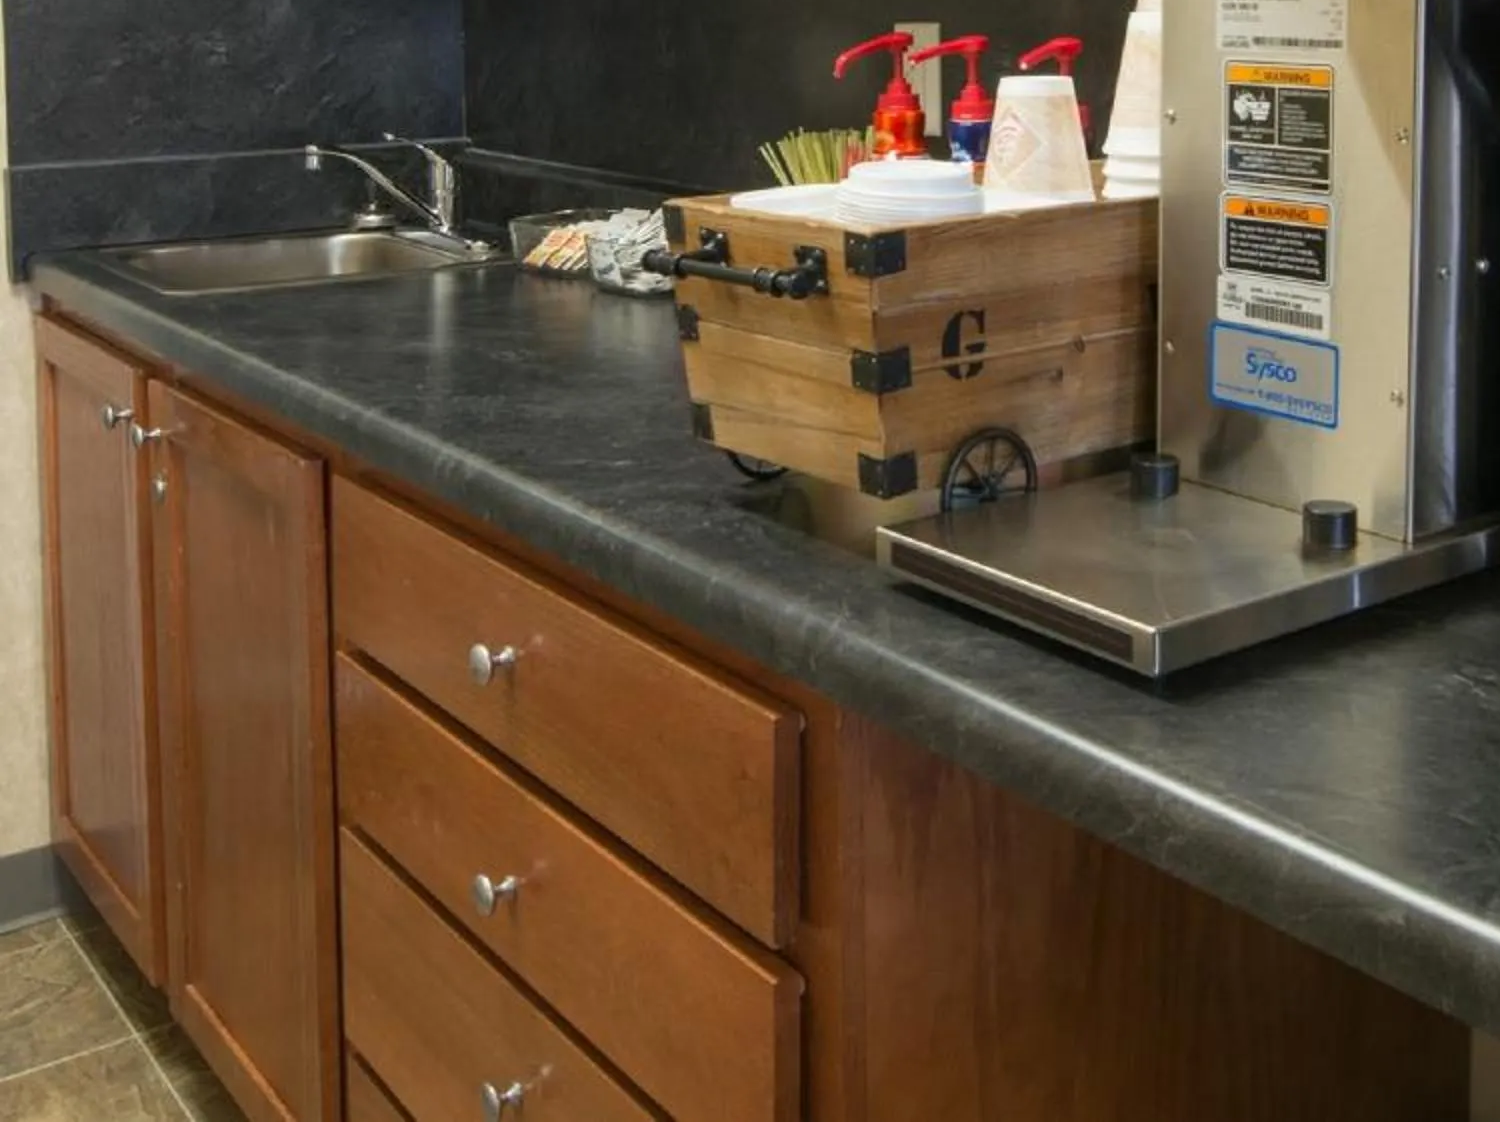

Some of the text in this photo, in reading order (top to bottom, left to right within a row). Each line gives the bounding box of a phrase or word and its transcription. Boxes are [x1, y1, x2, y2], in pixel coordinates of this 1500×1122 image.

[1257, 205, 1309, 221] WARNING
[941, 309, 986, 380] G
[1245, 351, 1297, 383] Sysco
